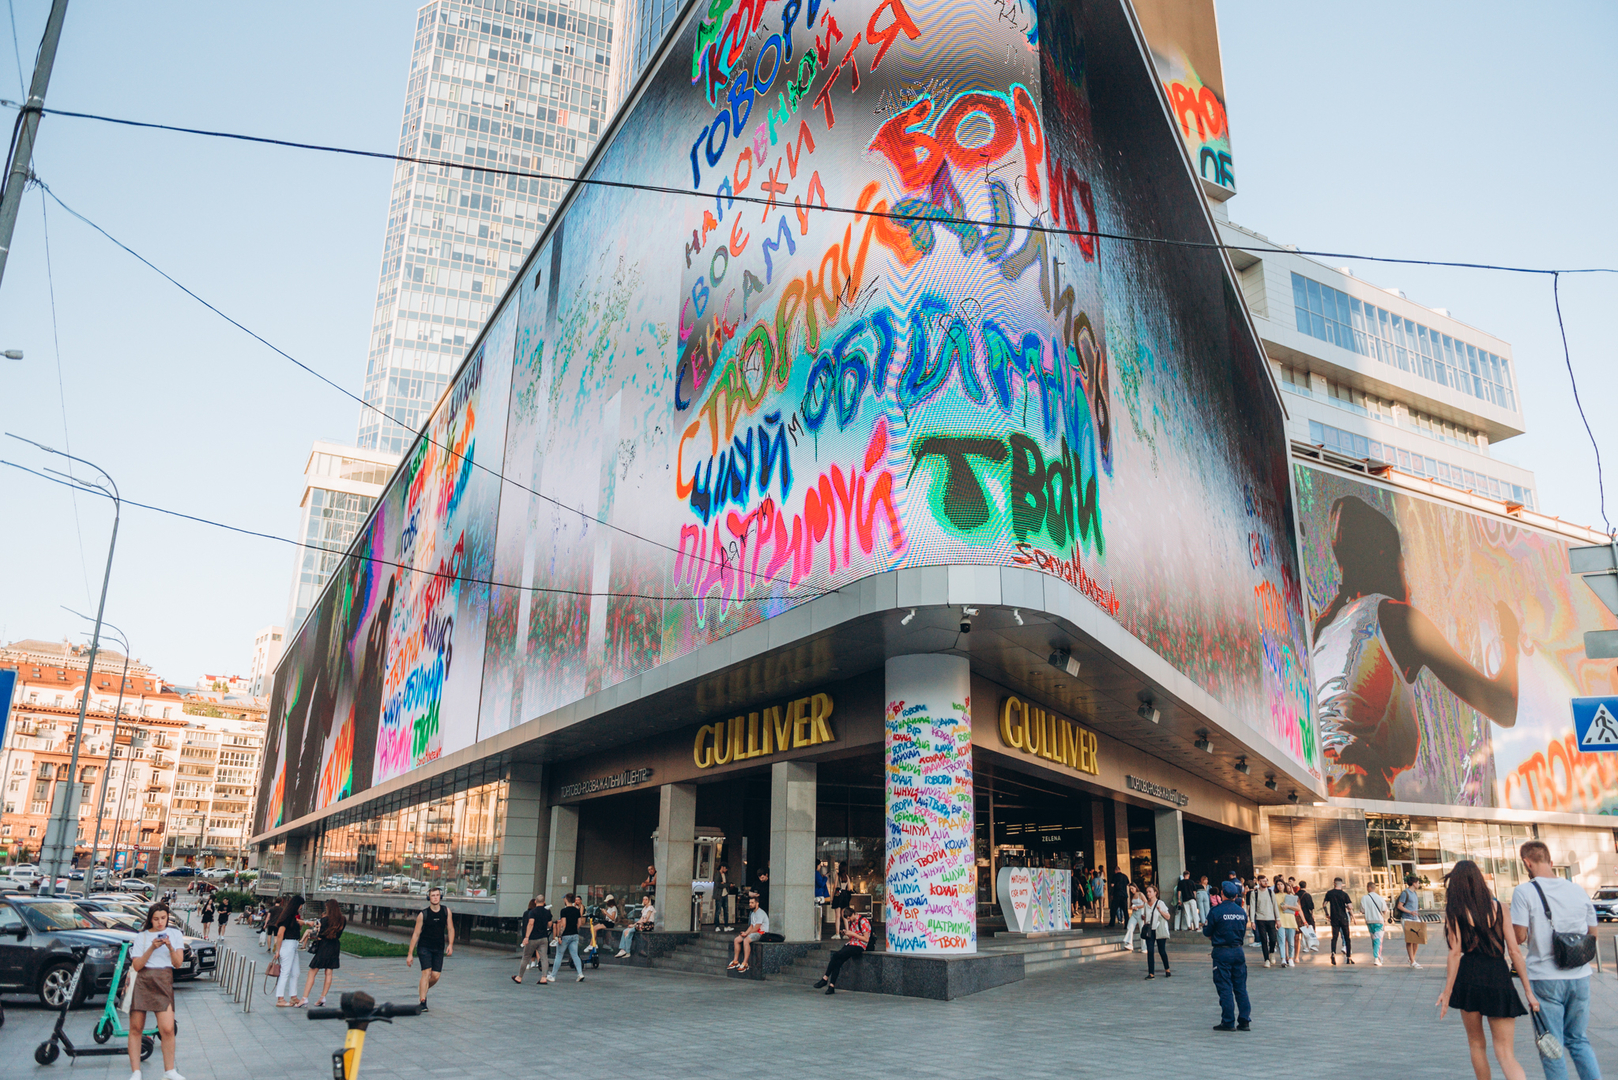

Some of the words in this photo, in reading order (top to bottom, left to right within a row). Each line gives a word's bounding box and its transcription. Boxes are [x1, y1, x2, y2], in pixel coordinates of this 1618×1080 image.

[694, 692, 836, 769] GULLIVER
[1002, 695, 1100, 776] GULLIVER
[901, 822, 931, 836] ЦІЛУЙ
[930, 827, 950, 842] ДІЙ
[914, 849, 947, 868] ТВОРИ
[929, 883, 958, 898] КОХАЙ
[904, 907, 919, 919] ВІР
[935, 935, 967, 948] ТВОРИ
